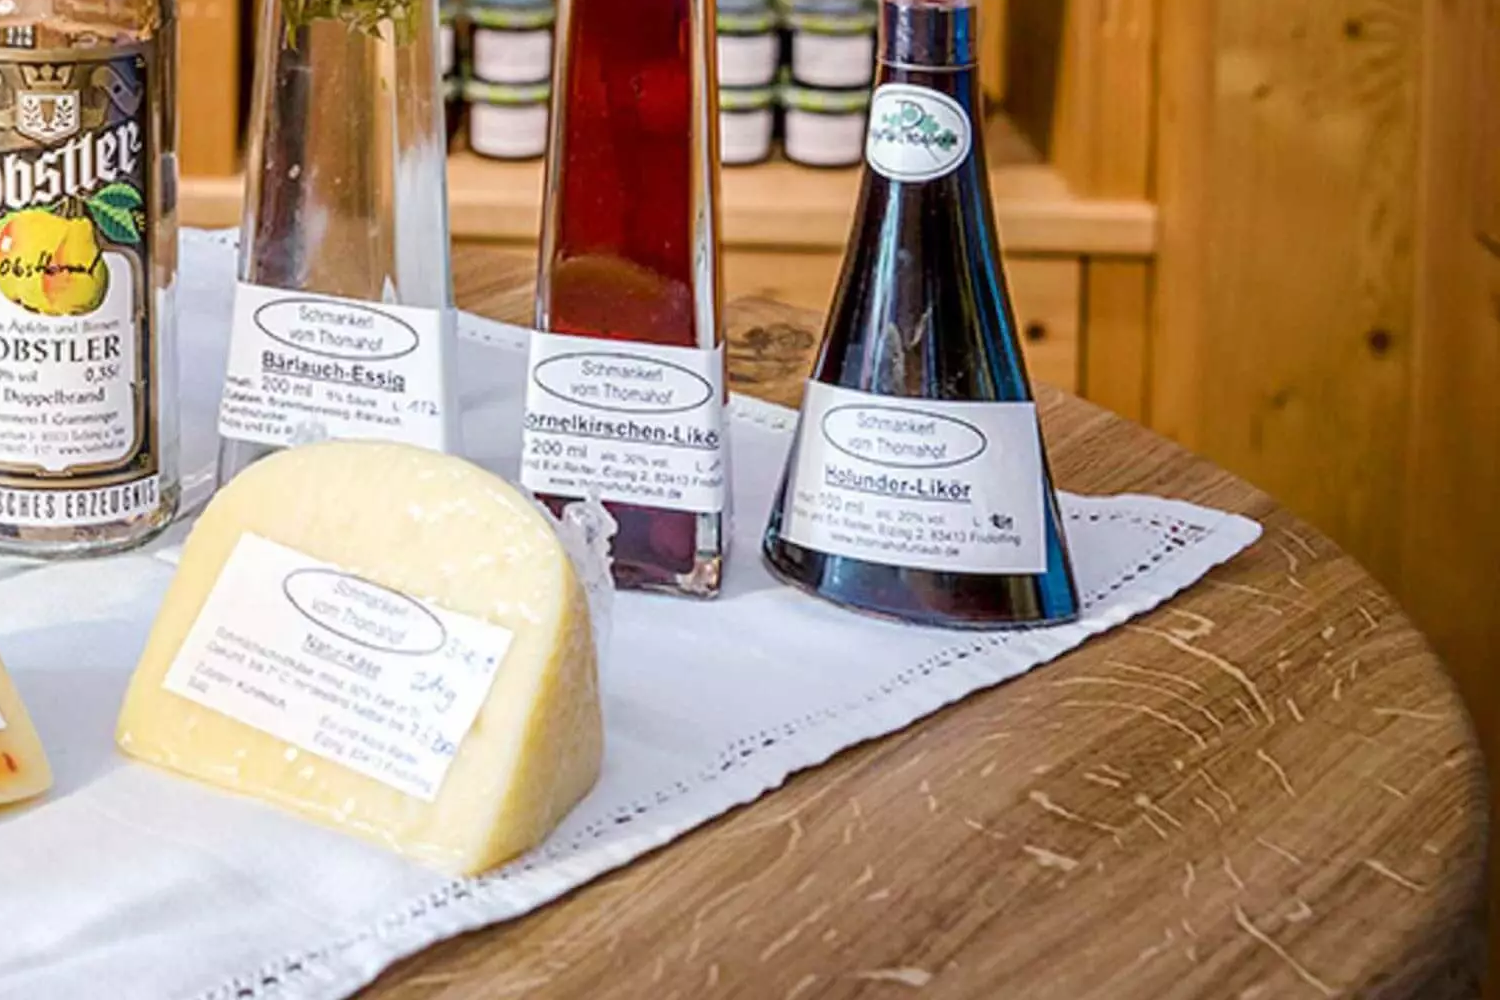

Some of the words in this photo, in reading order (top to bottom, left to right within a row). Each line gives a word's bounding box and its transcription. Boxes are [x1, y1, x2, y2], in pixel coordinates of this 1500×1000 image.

[298, 304, 374, 328] Schmankerl
[288, 330, 315, 341] vom
[261, 350, 406, 392] Bärlauch-Essig
[581, 360, 663, 382] Schmankerl
[261, 376, 290, 394] 200
[293, 382, 313, 398] ml
[570, 383, 599, 396] vom
[856, 411, 936, 435] Schmankerl
[531, 438, 562, 456] 200
[566, 444, 587, 459] ml
[825, 464, 972, 503] Holunder-Likör
[65, 479, 156, 519] ERZEUGNIS
